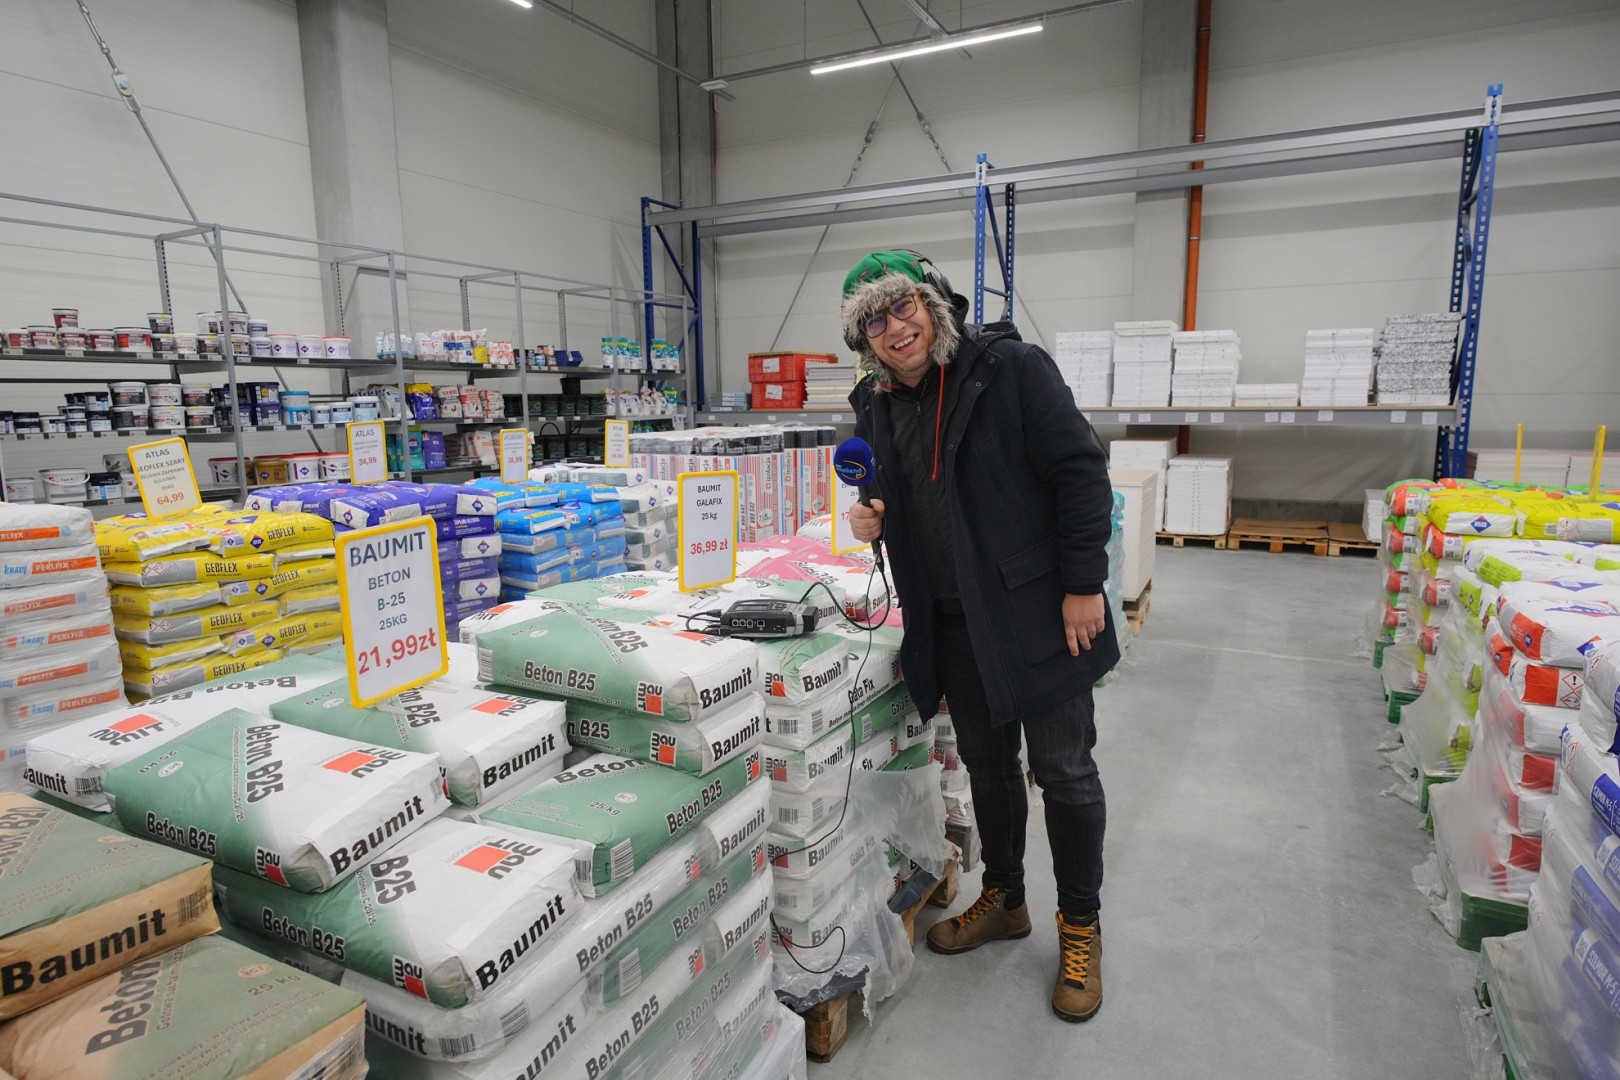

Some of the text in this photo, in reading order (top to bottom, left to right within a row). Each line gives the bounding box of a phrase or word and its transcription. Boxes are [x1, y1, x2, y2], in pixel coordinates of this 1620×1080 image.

[356, 429, 374, 438] ATLAS
[145, 448, 170, 459] ATLAS
[166, 458, 186, 466] SZARY
[358, 456, 376, 466] 34,99
[157, 492, 185, 506] 64,99
[697, 484, 722, 494] BAUMIT
[696, 498, 722, 507] GALAFIX
[710, 512, 718, 520] kg
[267, 527, 296, 540] GEOFLEX
[350, 531, 426, 568] BAUMIT
[690, 539, 728, 555] 36,99 zł
[36, 561, 68, 571] PERLFIX
[205, 562, 238, 573] GEOFLEX
[271, 570, 300, 585] GEOFLEX
[368, 567, 410, 590] BETON
[9, 602, 42, 612] PERLFIX
[378, 592, 406, 611] B-25
[210, 613, 243, 626] GEOFLEX
[279, 624, 308, 638] GEOFLEX
[379, 614, 408, 630] 25KG
[52, 630, 84, 640] PERLFIX
[609, 630, 648, 653] B25
[358, 628, 437, 675] 21,99zł
[22, 672, 54, 682] PERLFIX
[212, 662, 246, 677] GEOFLEX
[524, 660, 596, 691] Beton B25
[803, 662, 842, 692] Baumit
[205, 676, 297, 694] Beton
[700, 667, 752, 710] Baumit
[862, 678, 875, 694] Fix
[62, 698, 93, 709] PERLFIX
[404, 703, 440, 728] B25
[580, 719, 610, 740] B25
[712, 716, 760, 762] Baumit
[246, 724, 284, 804] Beton B25
[483, 733, 556, 788] Baumit
[554, 758, 645, 784] Beton
[808, 746, 844, 779] Baumit
[590, 801, 621, 816] 25 kg
[666, 780, 722, 834] Beton B25
[147, 812, 216, 856] Beton B25
[330, 795, 425, 875] Baumit
[720, 807, 766, 858] Baumit
[808, 828, 844, 867] Baumit
[370, 855, 416, 905] B25
[672, 876, 728, 938] Beton B25
[262, 908, 345, 961] Beton B25
[576, 896, 653, 972] Beton B25
[724, 896, 768, 952] Baumit
[812, 903, 848, 946] Baumit
[1, 909, 166, 996] Baumit
[476, 894, 566, 992] Baumit
[248, 974, 302, 997] 25 kg
[85, 960, 164, 1056] Beton
[675, 972, 730, 1040] Beton B25
[364, 1008, 428, 1055] aumit
[585, 995, 660, 1080] Beton B25
[516, 1014, 576, 1080] umit
